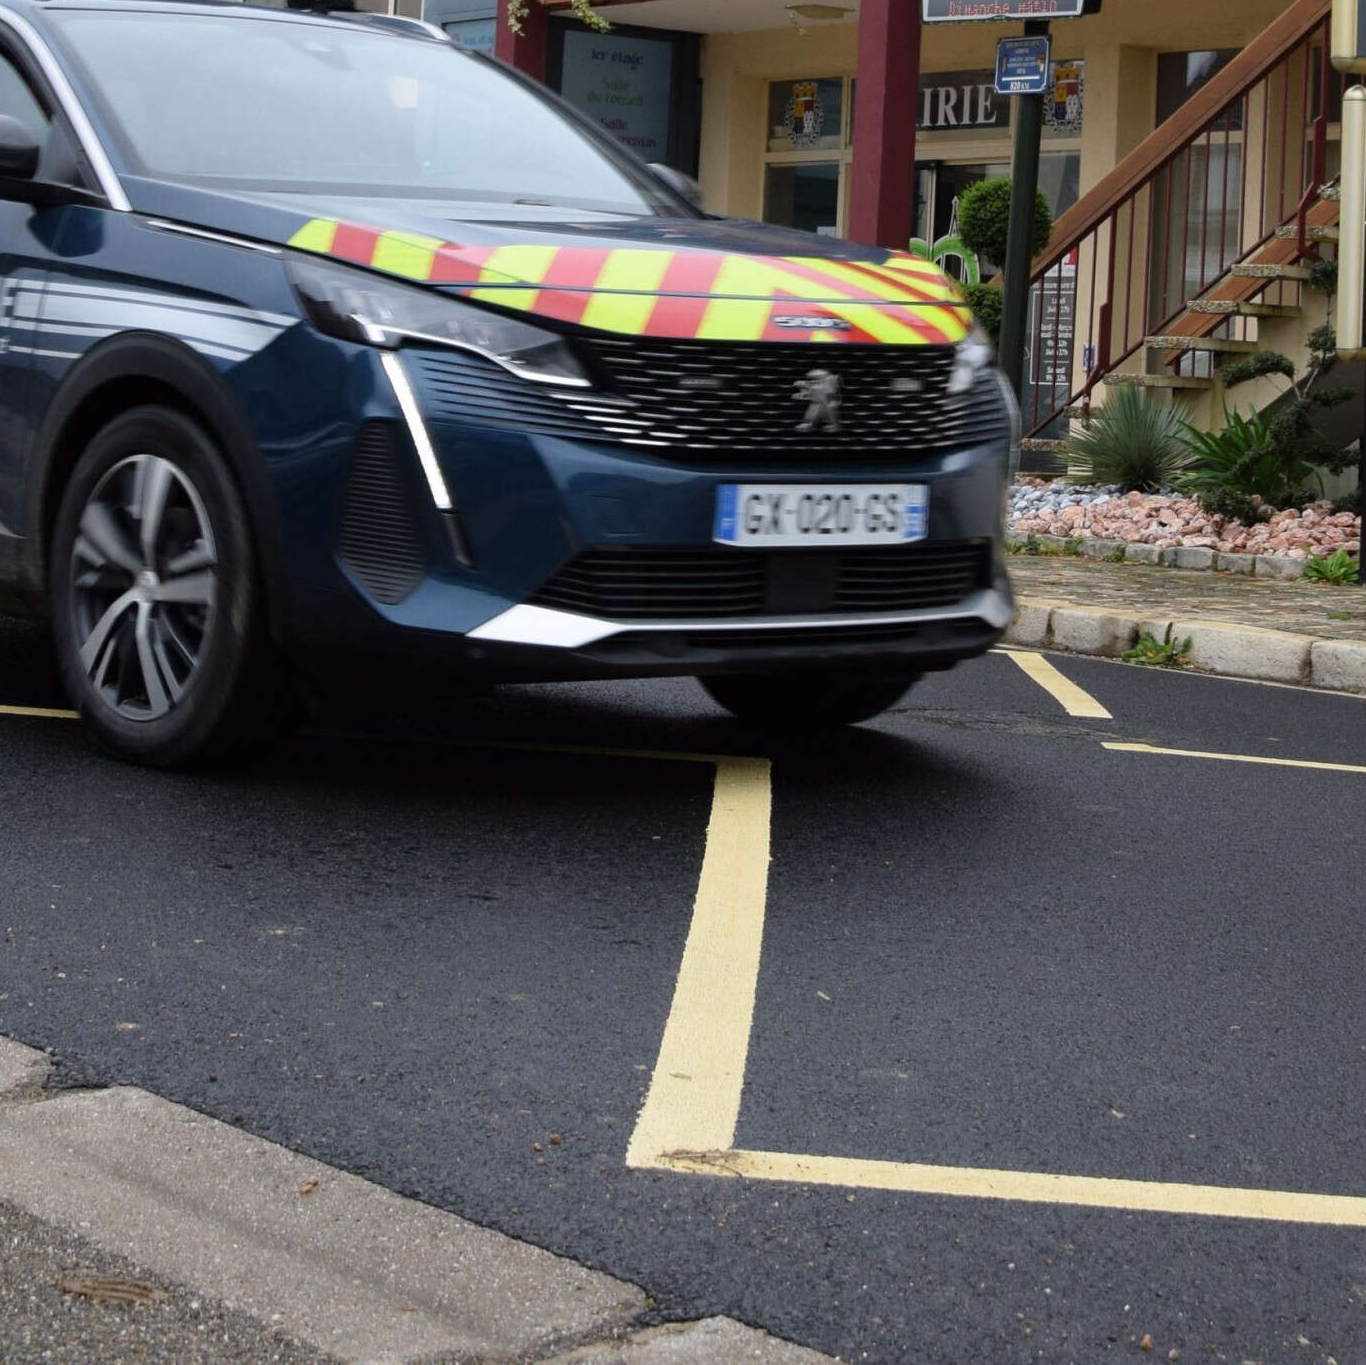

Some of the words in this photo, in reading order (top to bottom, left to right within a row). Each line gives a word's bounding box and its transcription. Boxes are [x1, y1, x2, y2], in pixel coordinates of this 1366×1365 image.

[948, 0, 1011, 17] Dimanche
[917, 83, 997, 127] IRIE
[744, 493, 902, 536] GX-020-GS
